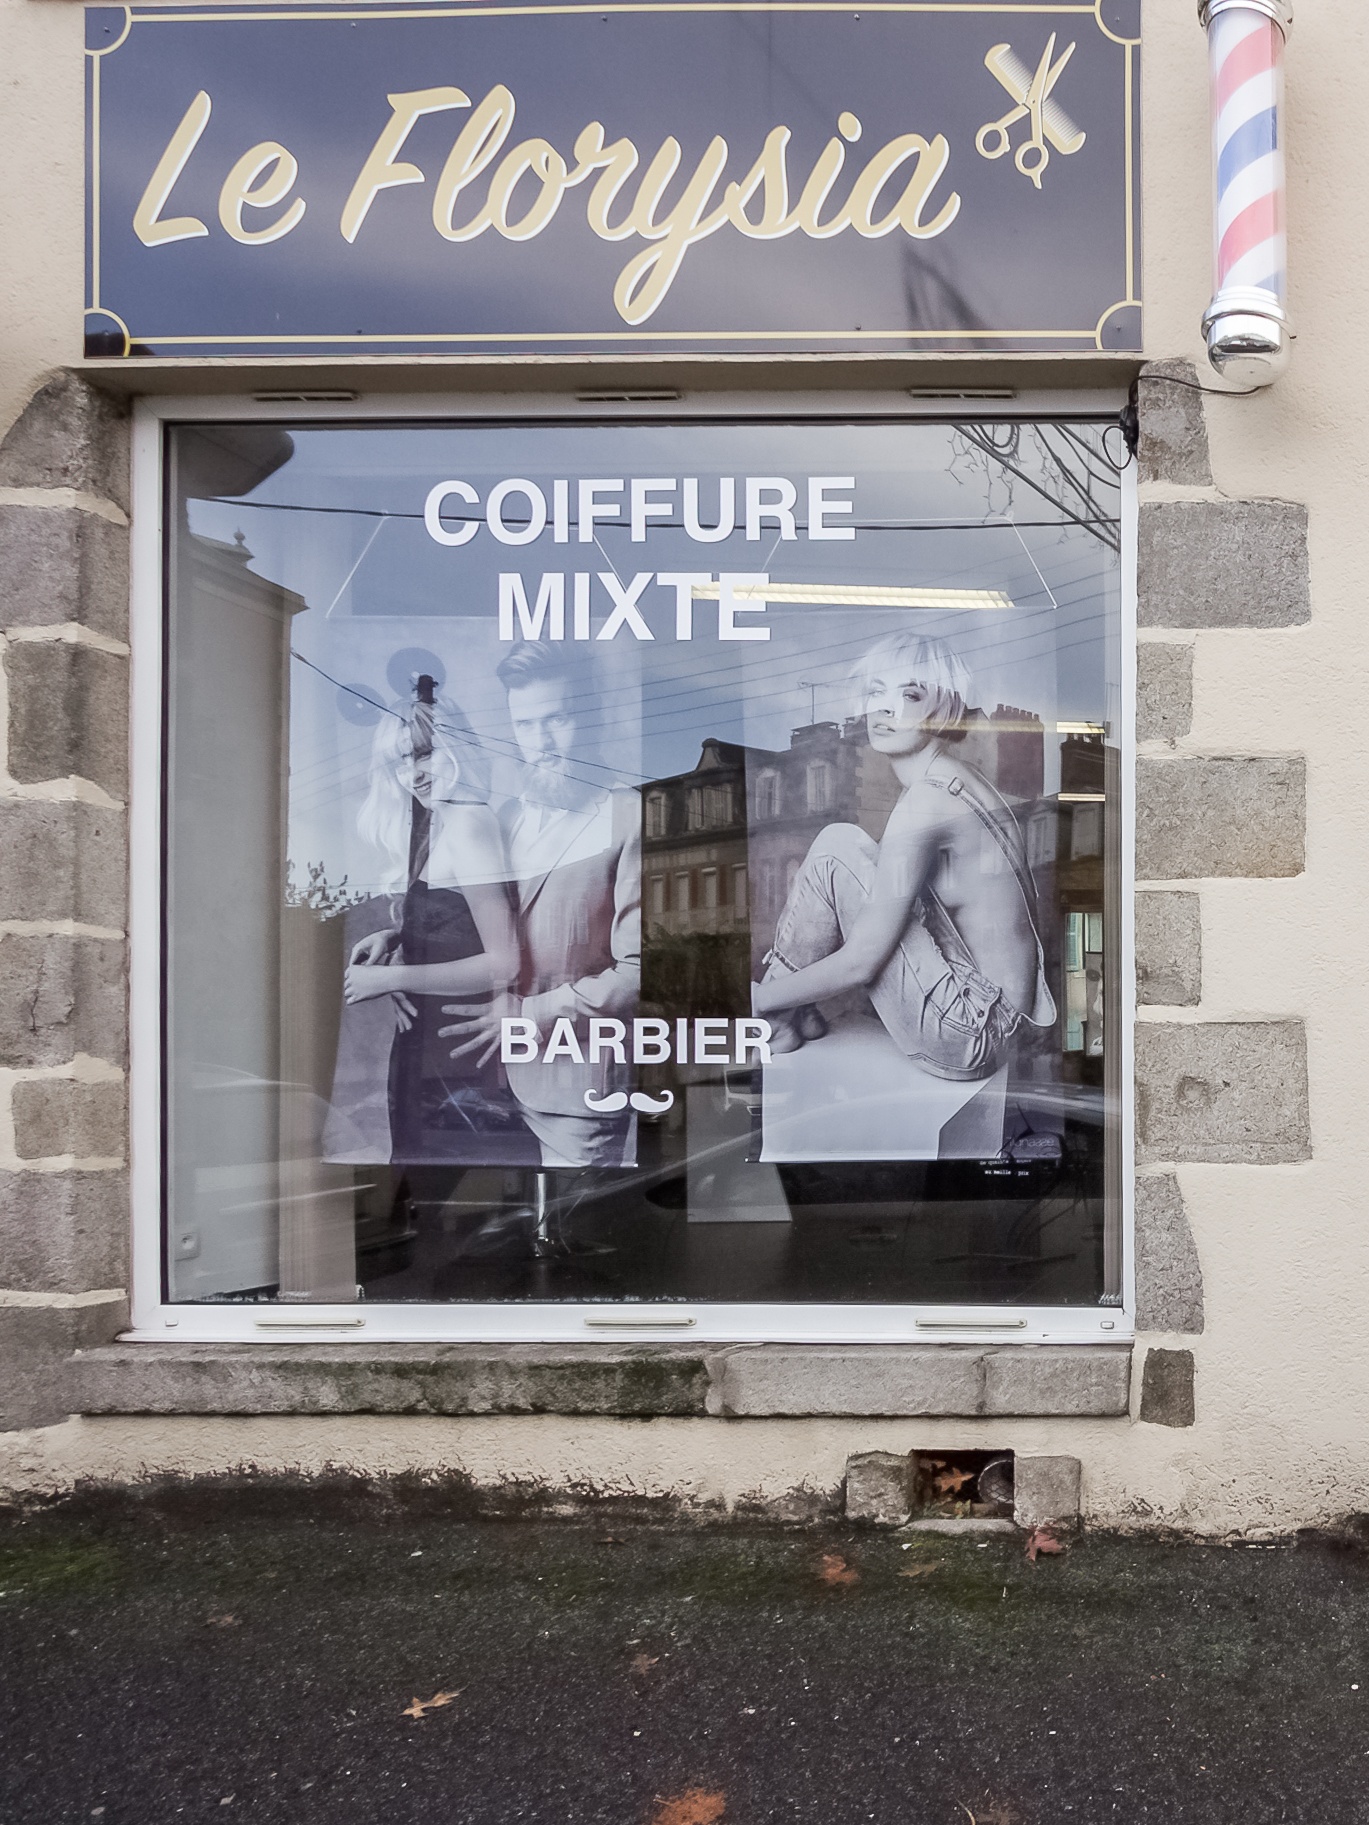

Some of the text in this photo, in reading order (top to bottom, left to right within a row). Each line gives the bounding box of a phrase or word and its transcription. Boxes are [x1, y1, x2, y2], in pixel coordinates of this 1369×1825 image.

[133, 83, 961, 325] Le Florysia
[423, 476, 856, 546] COIFFURE
[498, 572, 771, 641] MIXTE
[500, 1017, 773, 1064] BARBIER
